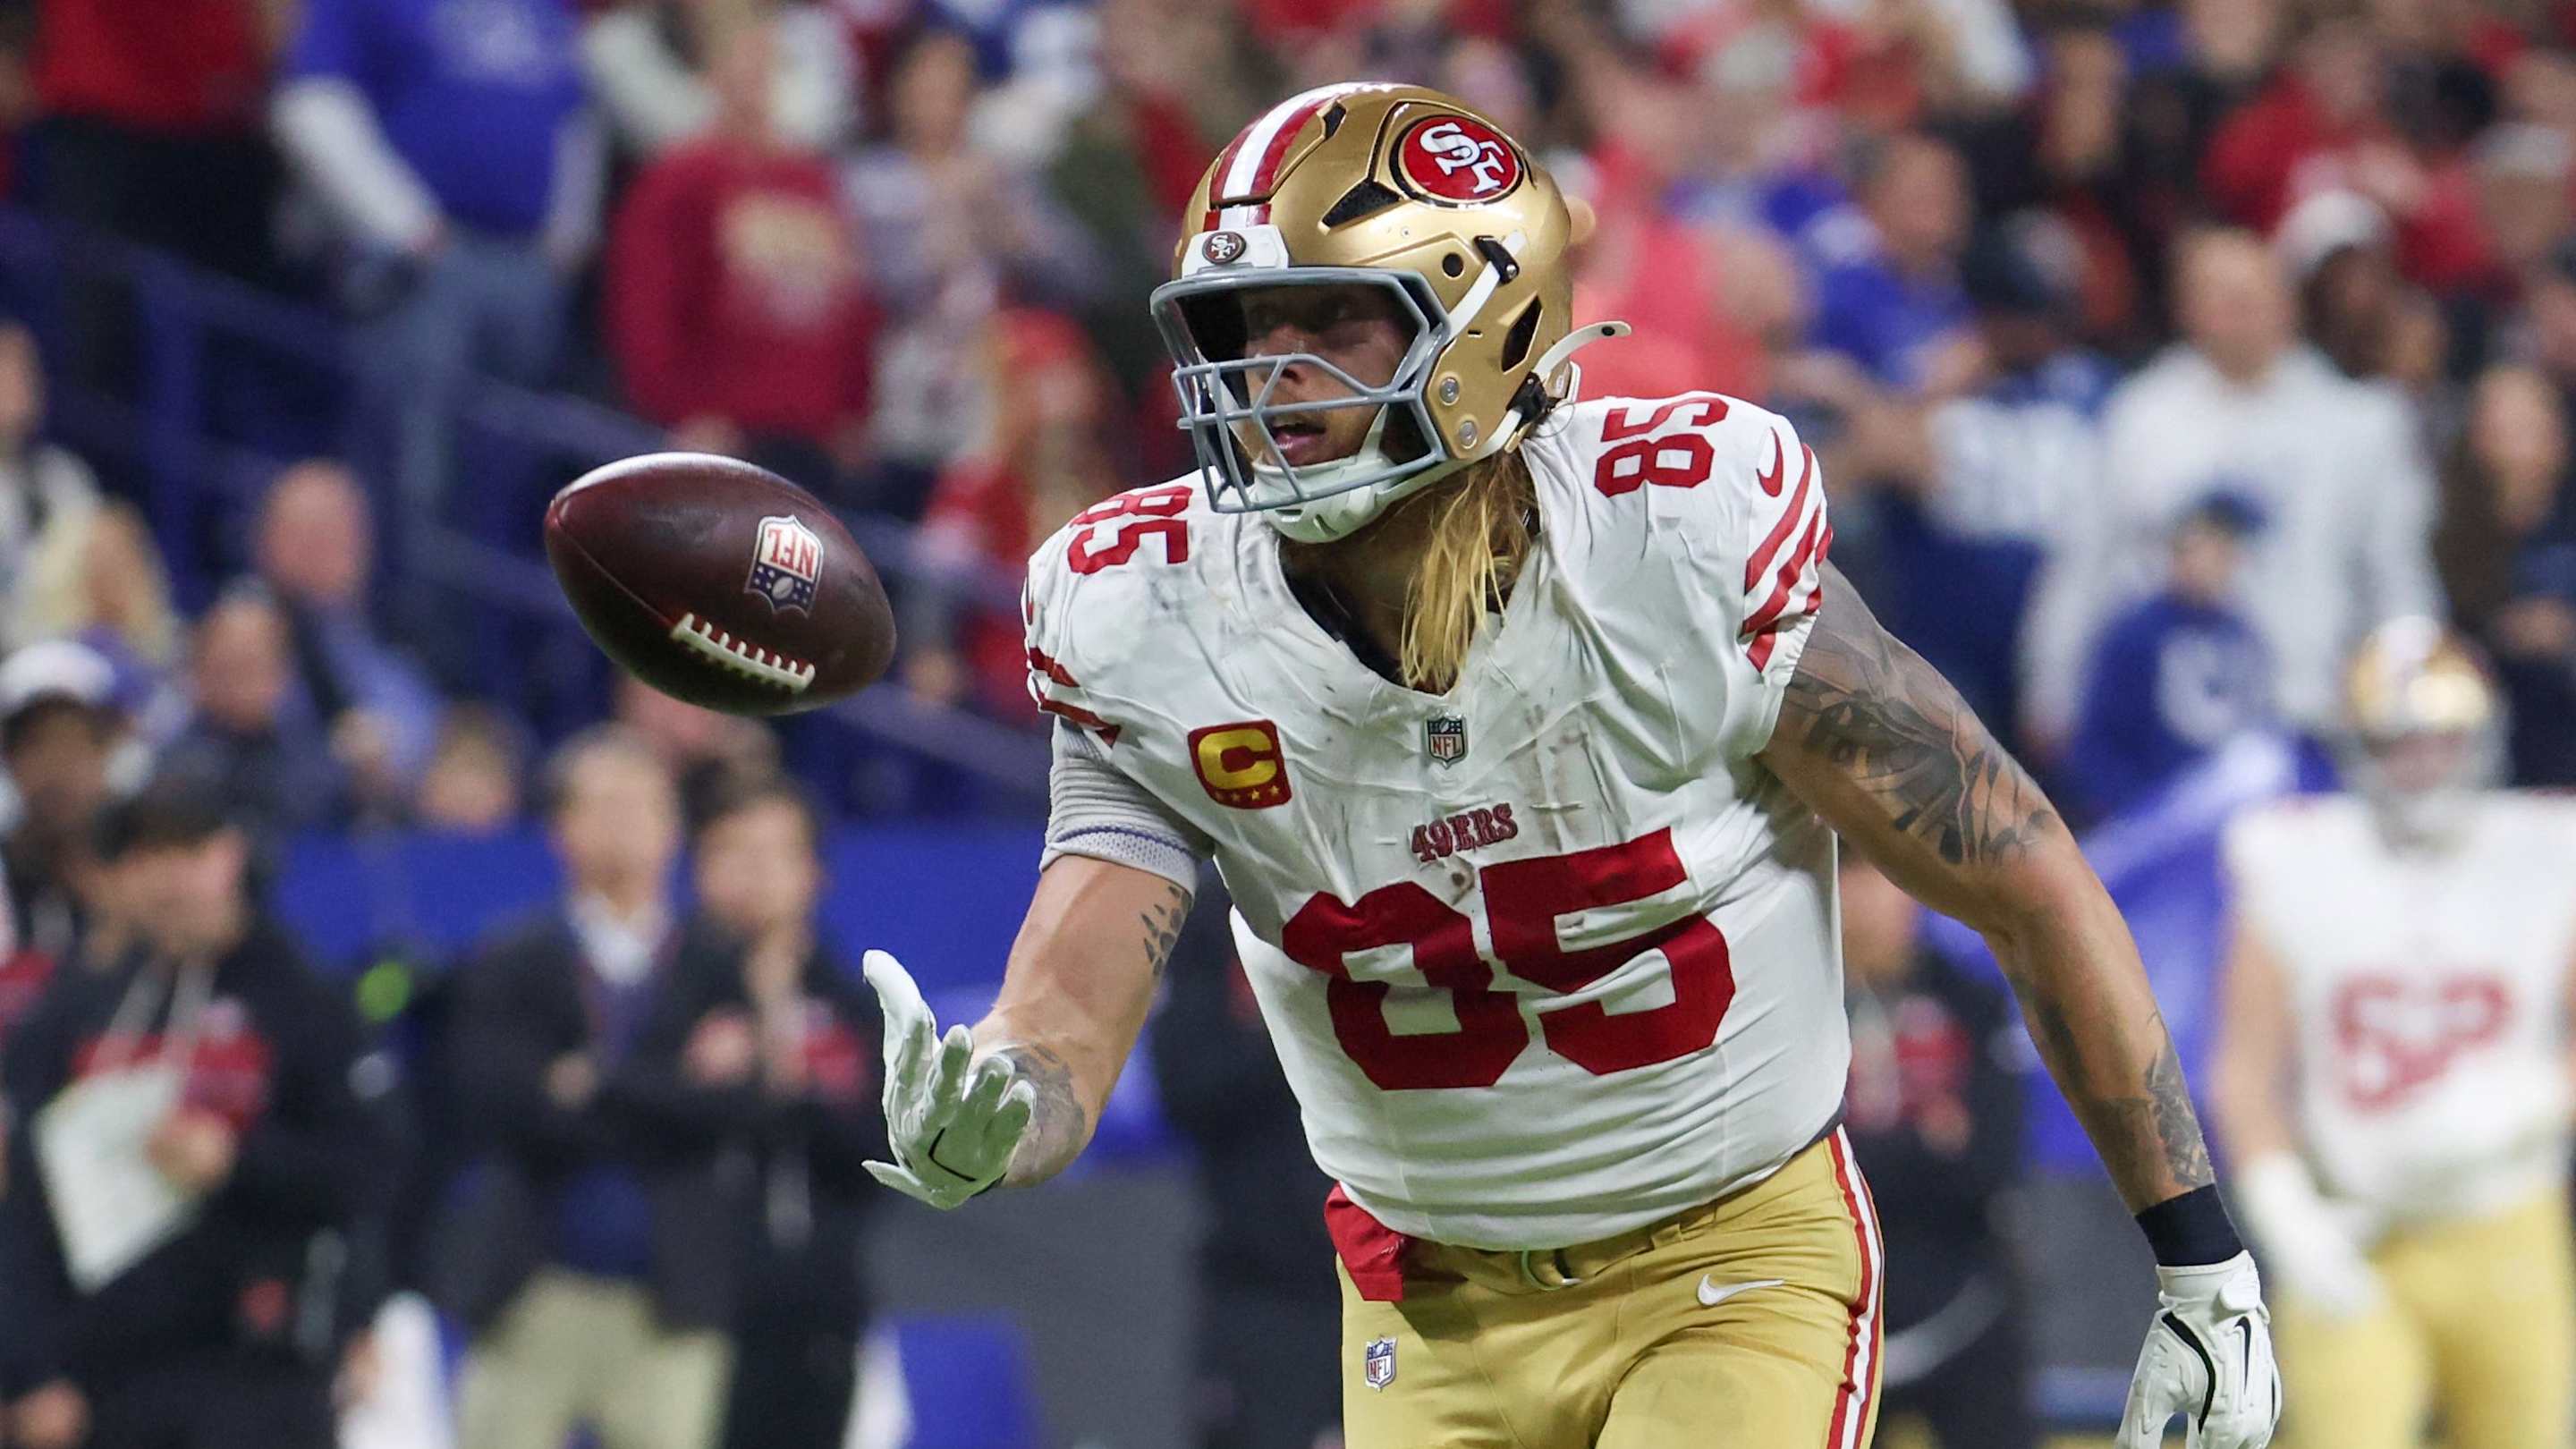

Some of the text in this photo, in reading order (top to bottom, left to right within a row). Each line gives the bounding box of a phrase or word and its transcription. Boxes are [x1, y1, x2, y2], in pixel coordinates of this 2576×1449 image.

[1419, 122, 1505, 194] SF
[1211, 234, 1236, 259] SF
[1593, 396, 1730, 498] 85
[767, 529, 816, 579] NFL
[1067, 485, 1194, 576] 85
[1198, 728, 1277, 790] C
[1432, 736, 1462, 758] NFL
[1411, 802, 1519, 862] 49ERS
[1282, 826, 1736, 1090] 85
[1369, 1358, 1390, 1380] NFL
